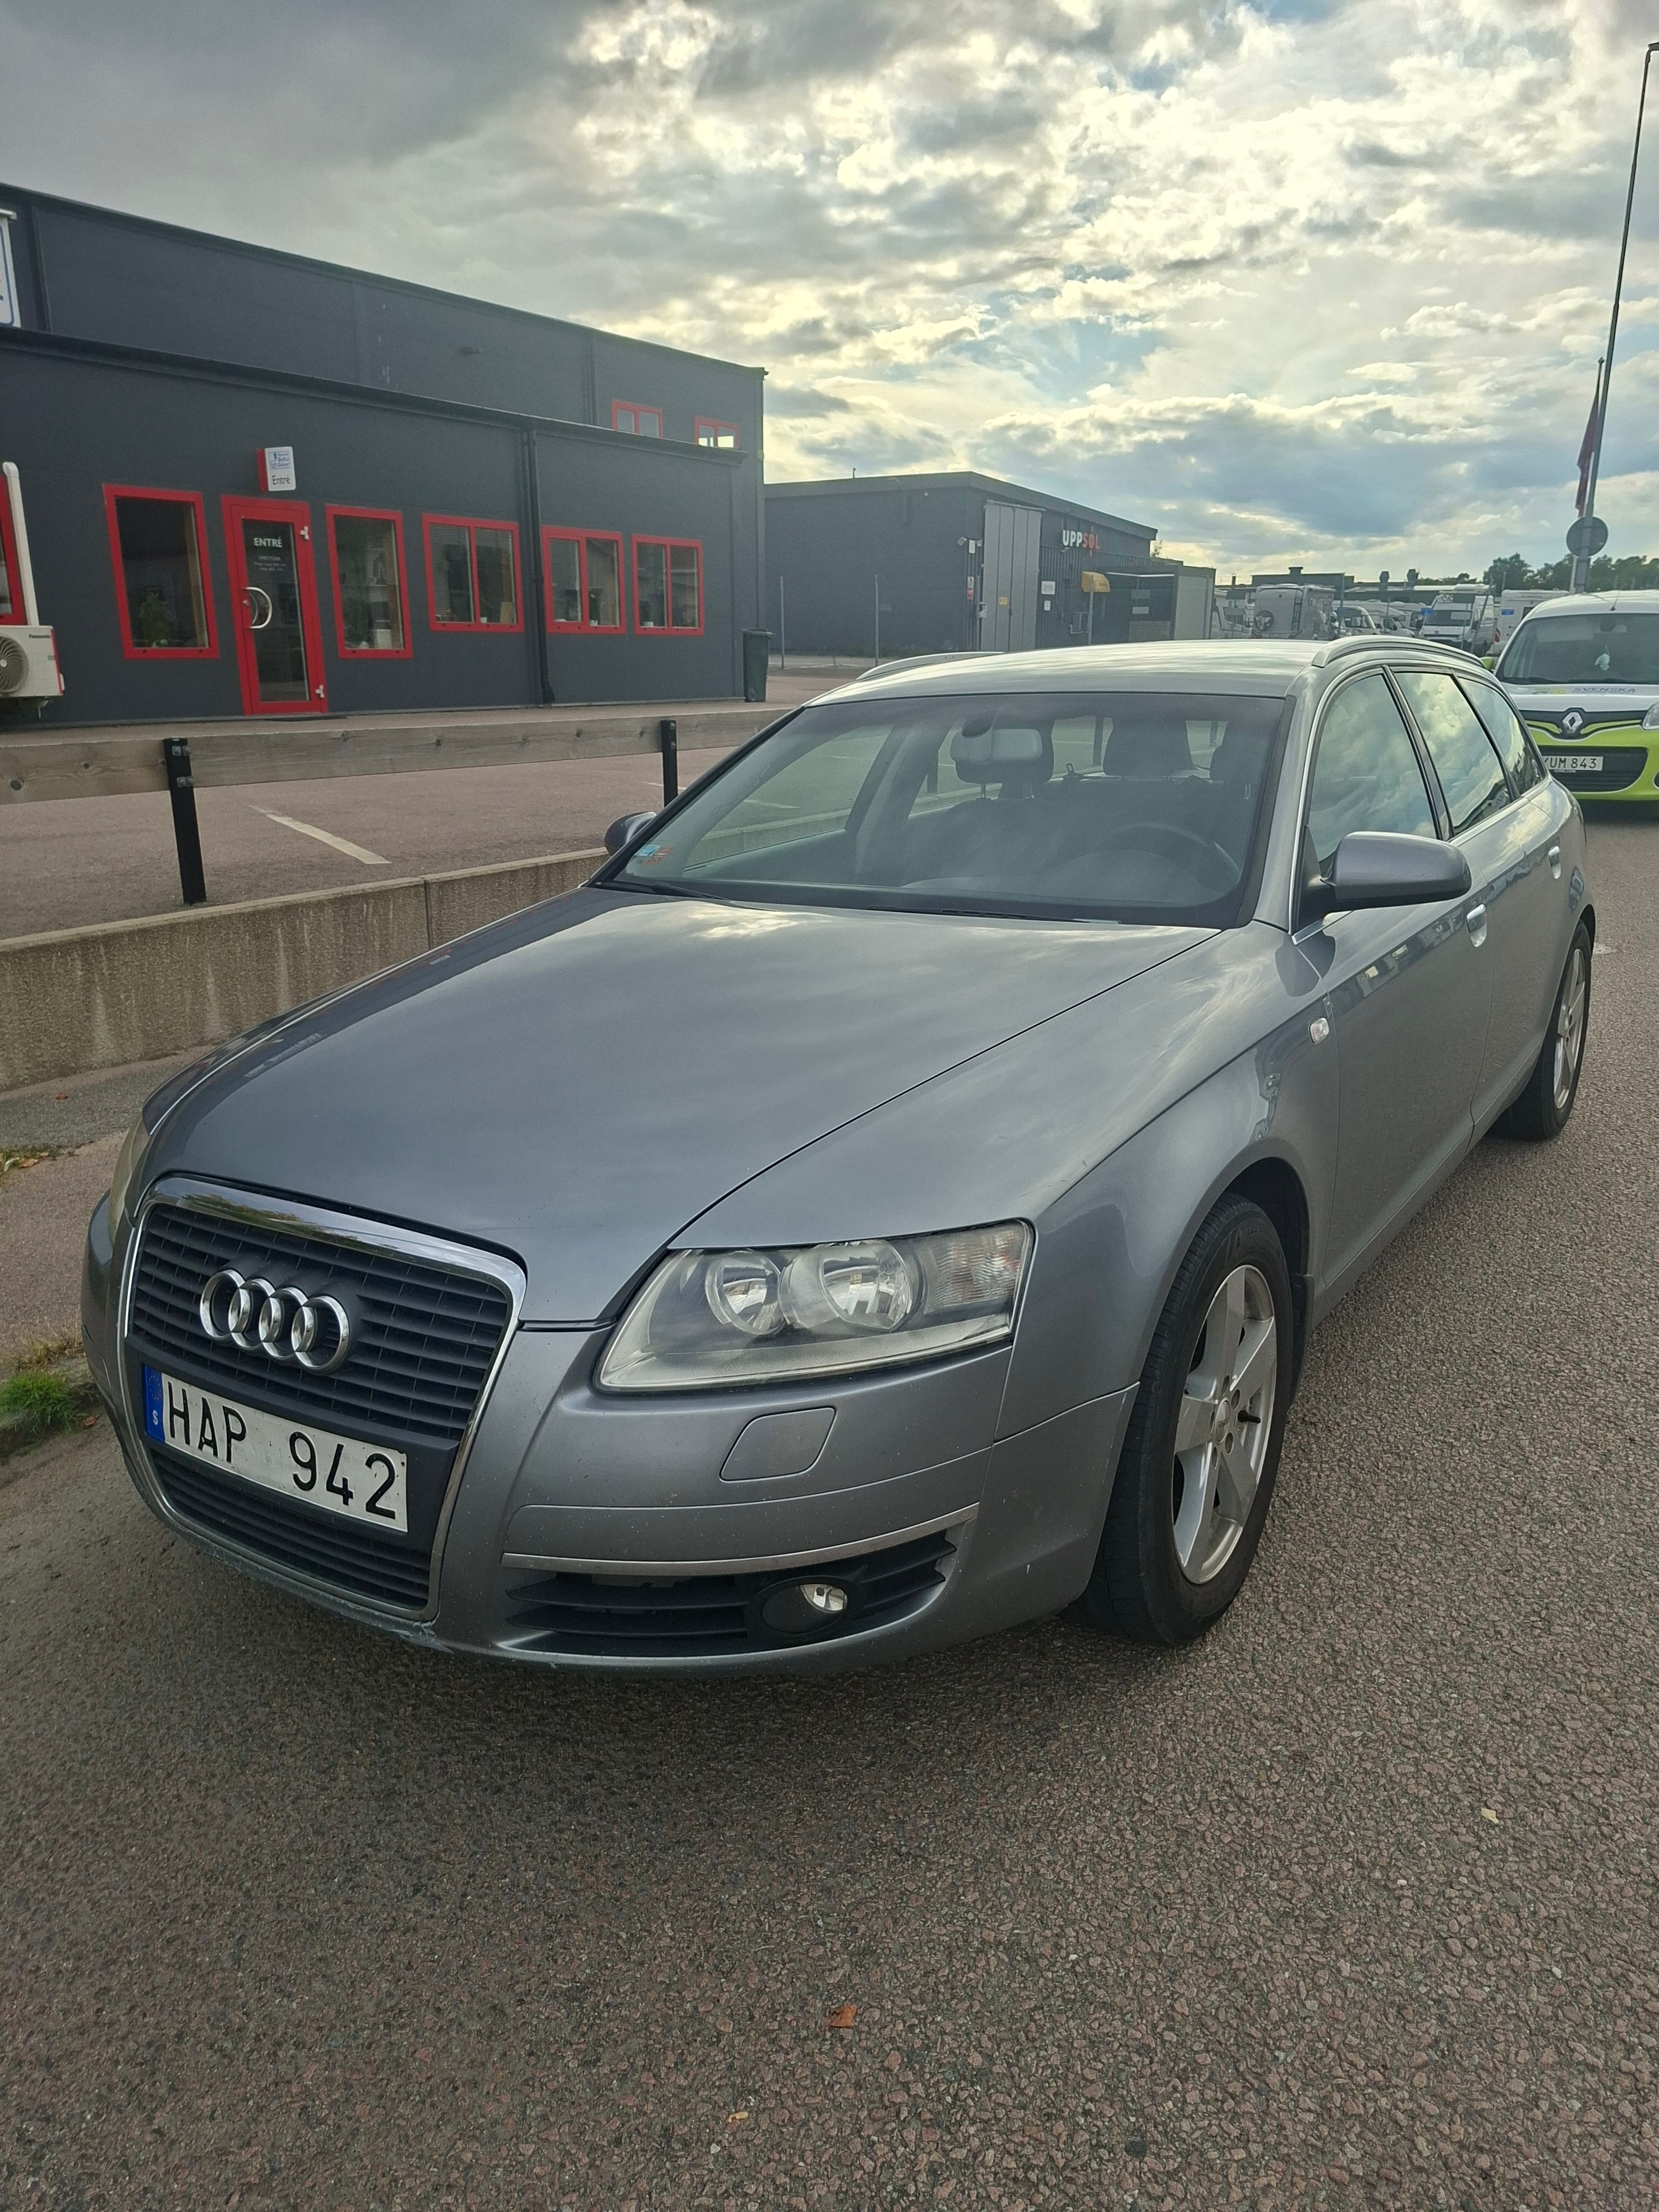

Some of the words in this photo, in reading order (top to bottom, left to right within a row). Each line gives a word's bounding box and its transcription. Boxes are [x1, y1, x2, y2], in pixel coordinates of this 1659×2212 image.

[272, 474, 291, 485] Entré
[253, 536, 283, 548] ENTRÉ
[1062, 529, 1100, 550] UPPSOL
[1571, 758, 1597, 769] 843
[153, 1410, 158, 1426] S
[168, 1381, 247, 1463] HAP
[289, 1431, 397, 1520] 942
